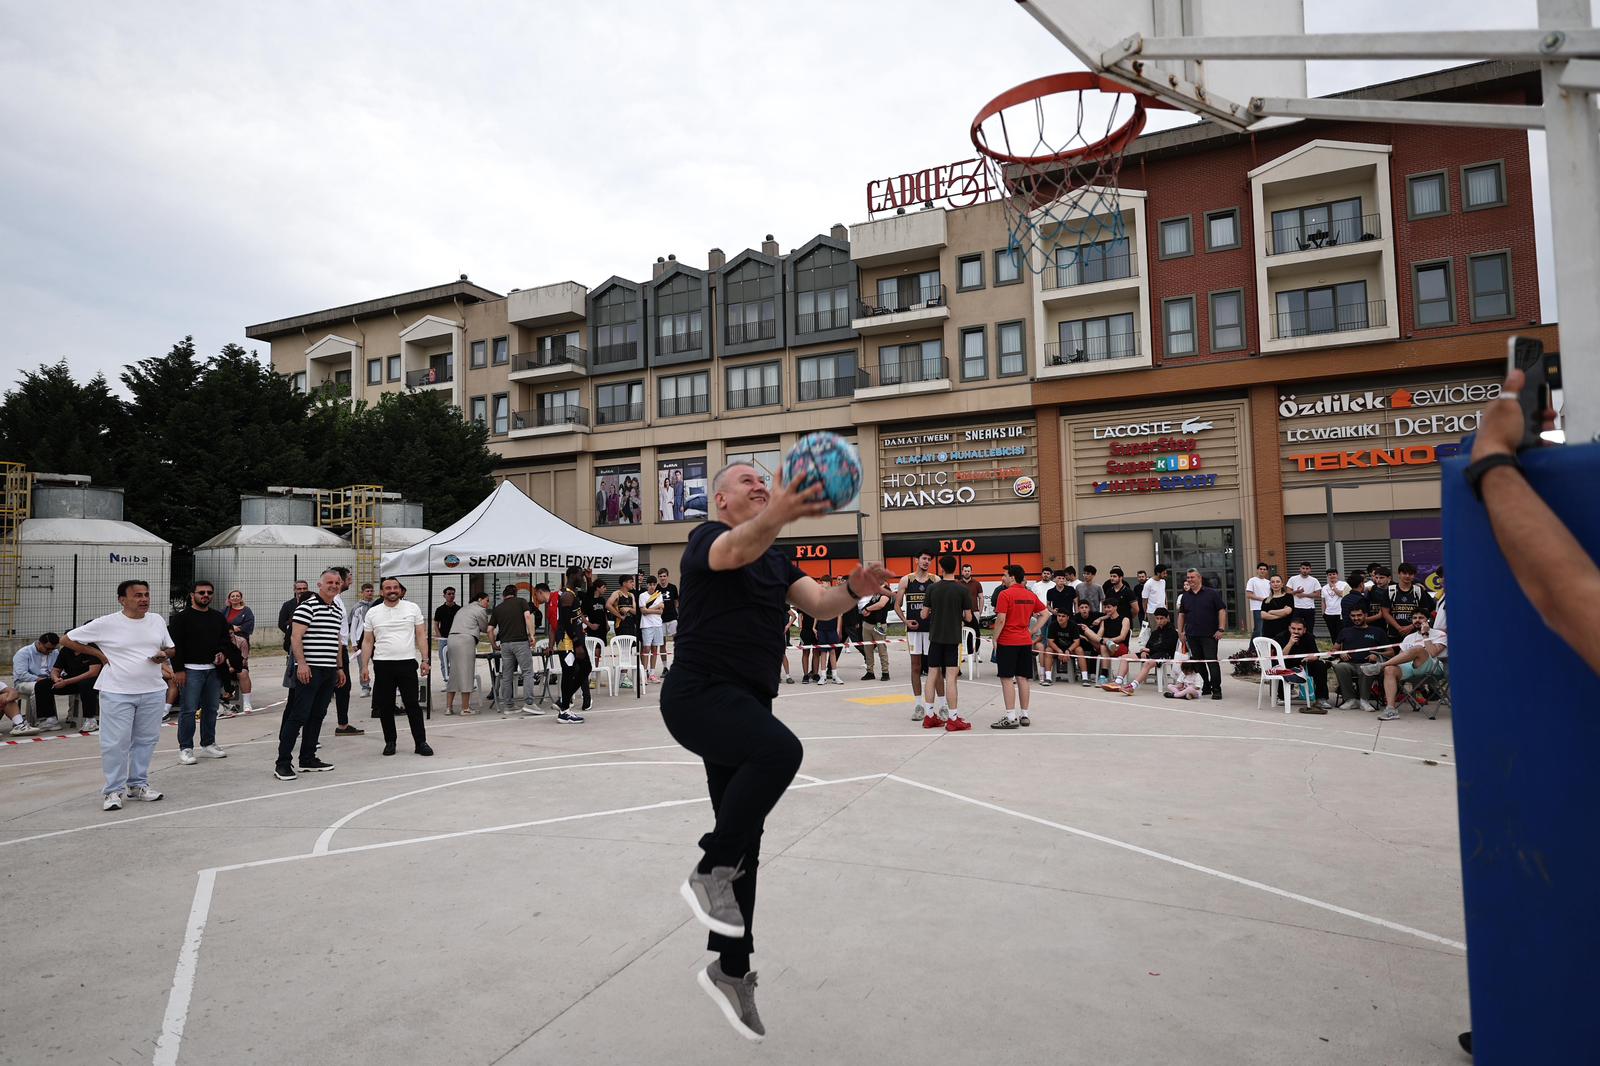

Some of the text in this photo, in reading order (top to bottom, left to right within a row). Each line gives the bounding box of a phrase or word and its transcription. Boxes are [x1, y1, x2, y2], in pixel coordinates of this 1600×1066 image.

[867, 156, 996, 213] CADDE 54
[1413, 383, 1502, 406] evidea
[1279, 391, 1385, 418] Özdilek
[1093, 421, 1172, 440] LACOSTE
[1394, 410, 1484, 437] DeFact
[884, 436, 919, 446] DAMAT
[965, 428, 1006, 441] SNEAKS
[1287, 428, 1310, 442] LC
[1109, 437, 1197, 456] SuperStep
[1109, 473, 1218, 493] INTERSPORT
[883, 486, 976, 508] MANGO
[795, 544, 828, 558] FLO
[939, 538, 976, 553] FLO
